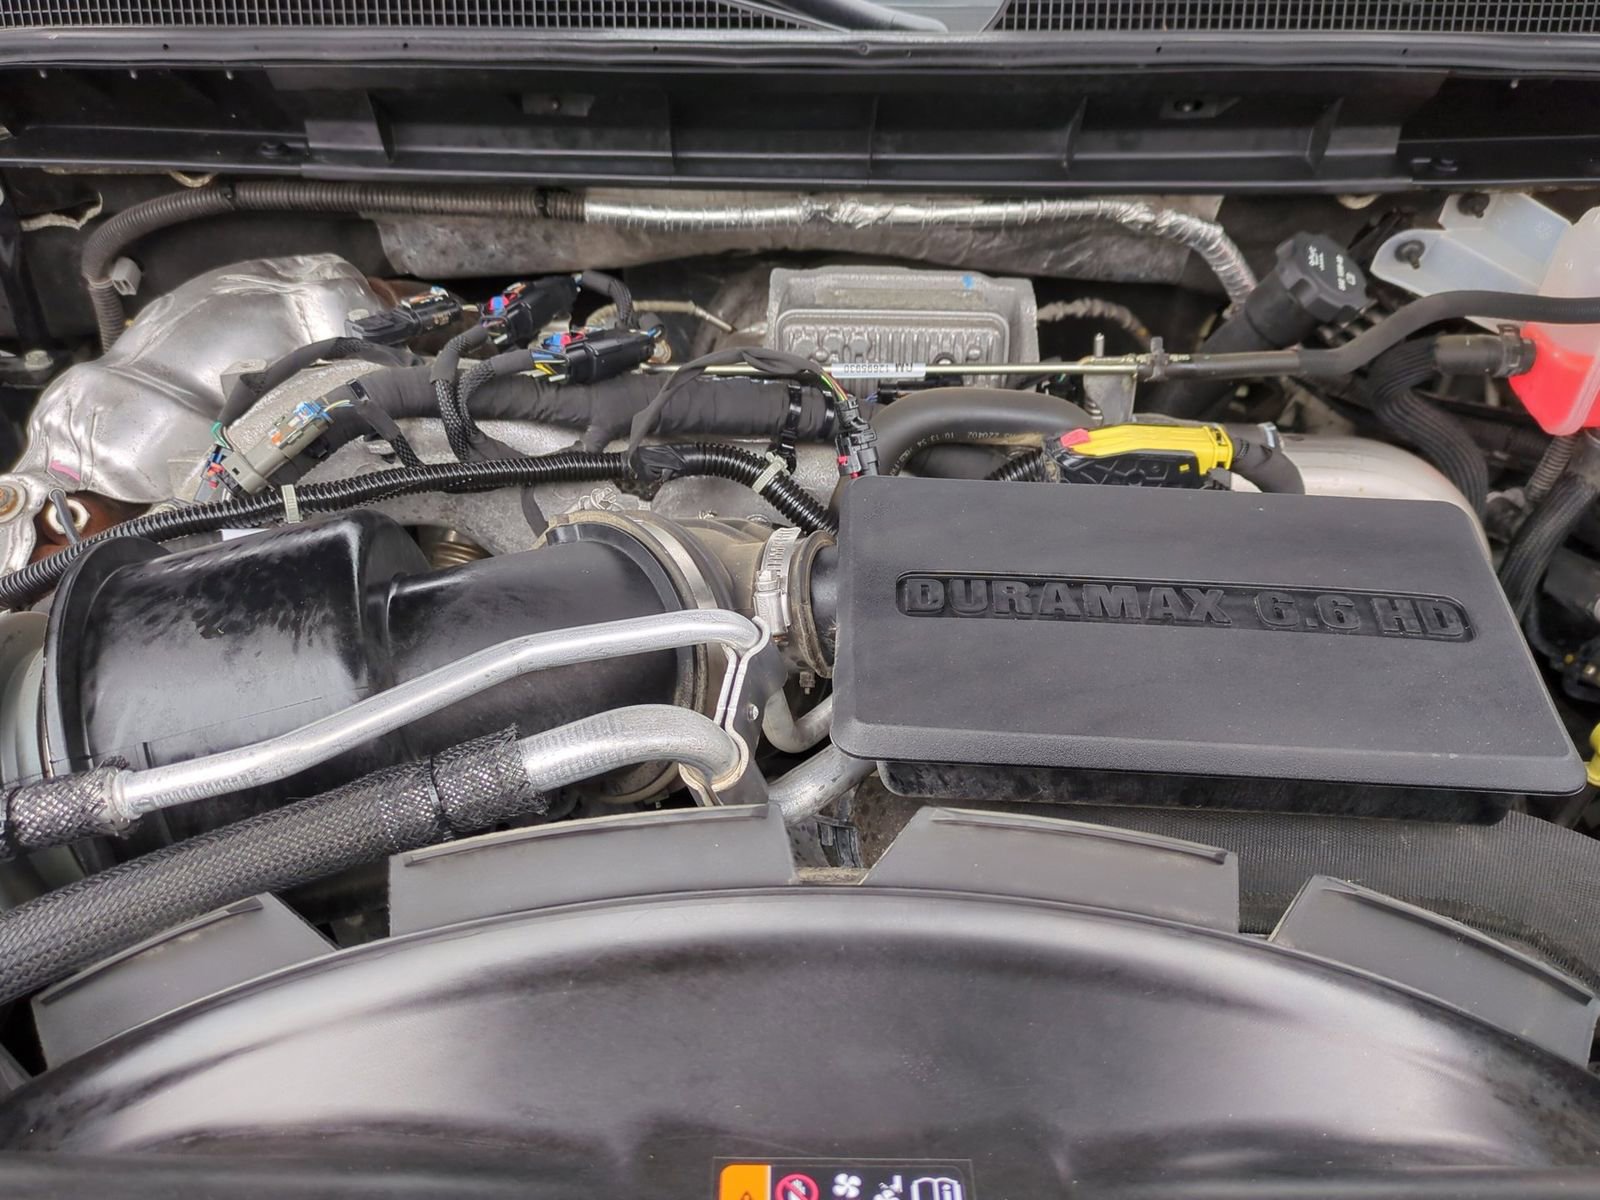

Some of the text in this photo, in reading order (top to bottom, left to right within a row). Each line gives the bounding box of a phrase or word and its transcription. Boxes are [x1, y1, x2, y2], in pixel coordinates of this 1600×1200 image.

[905, 577, 1465, 638] DURAMAX 6.6 HD
